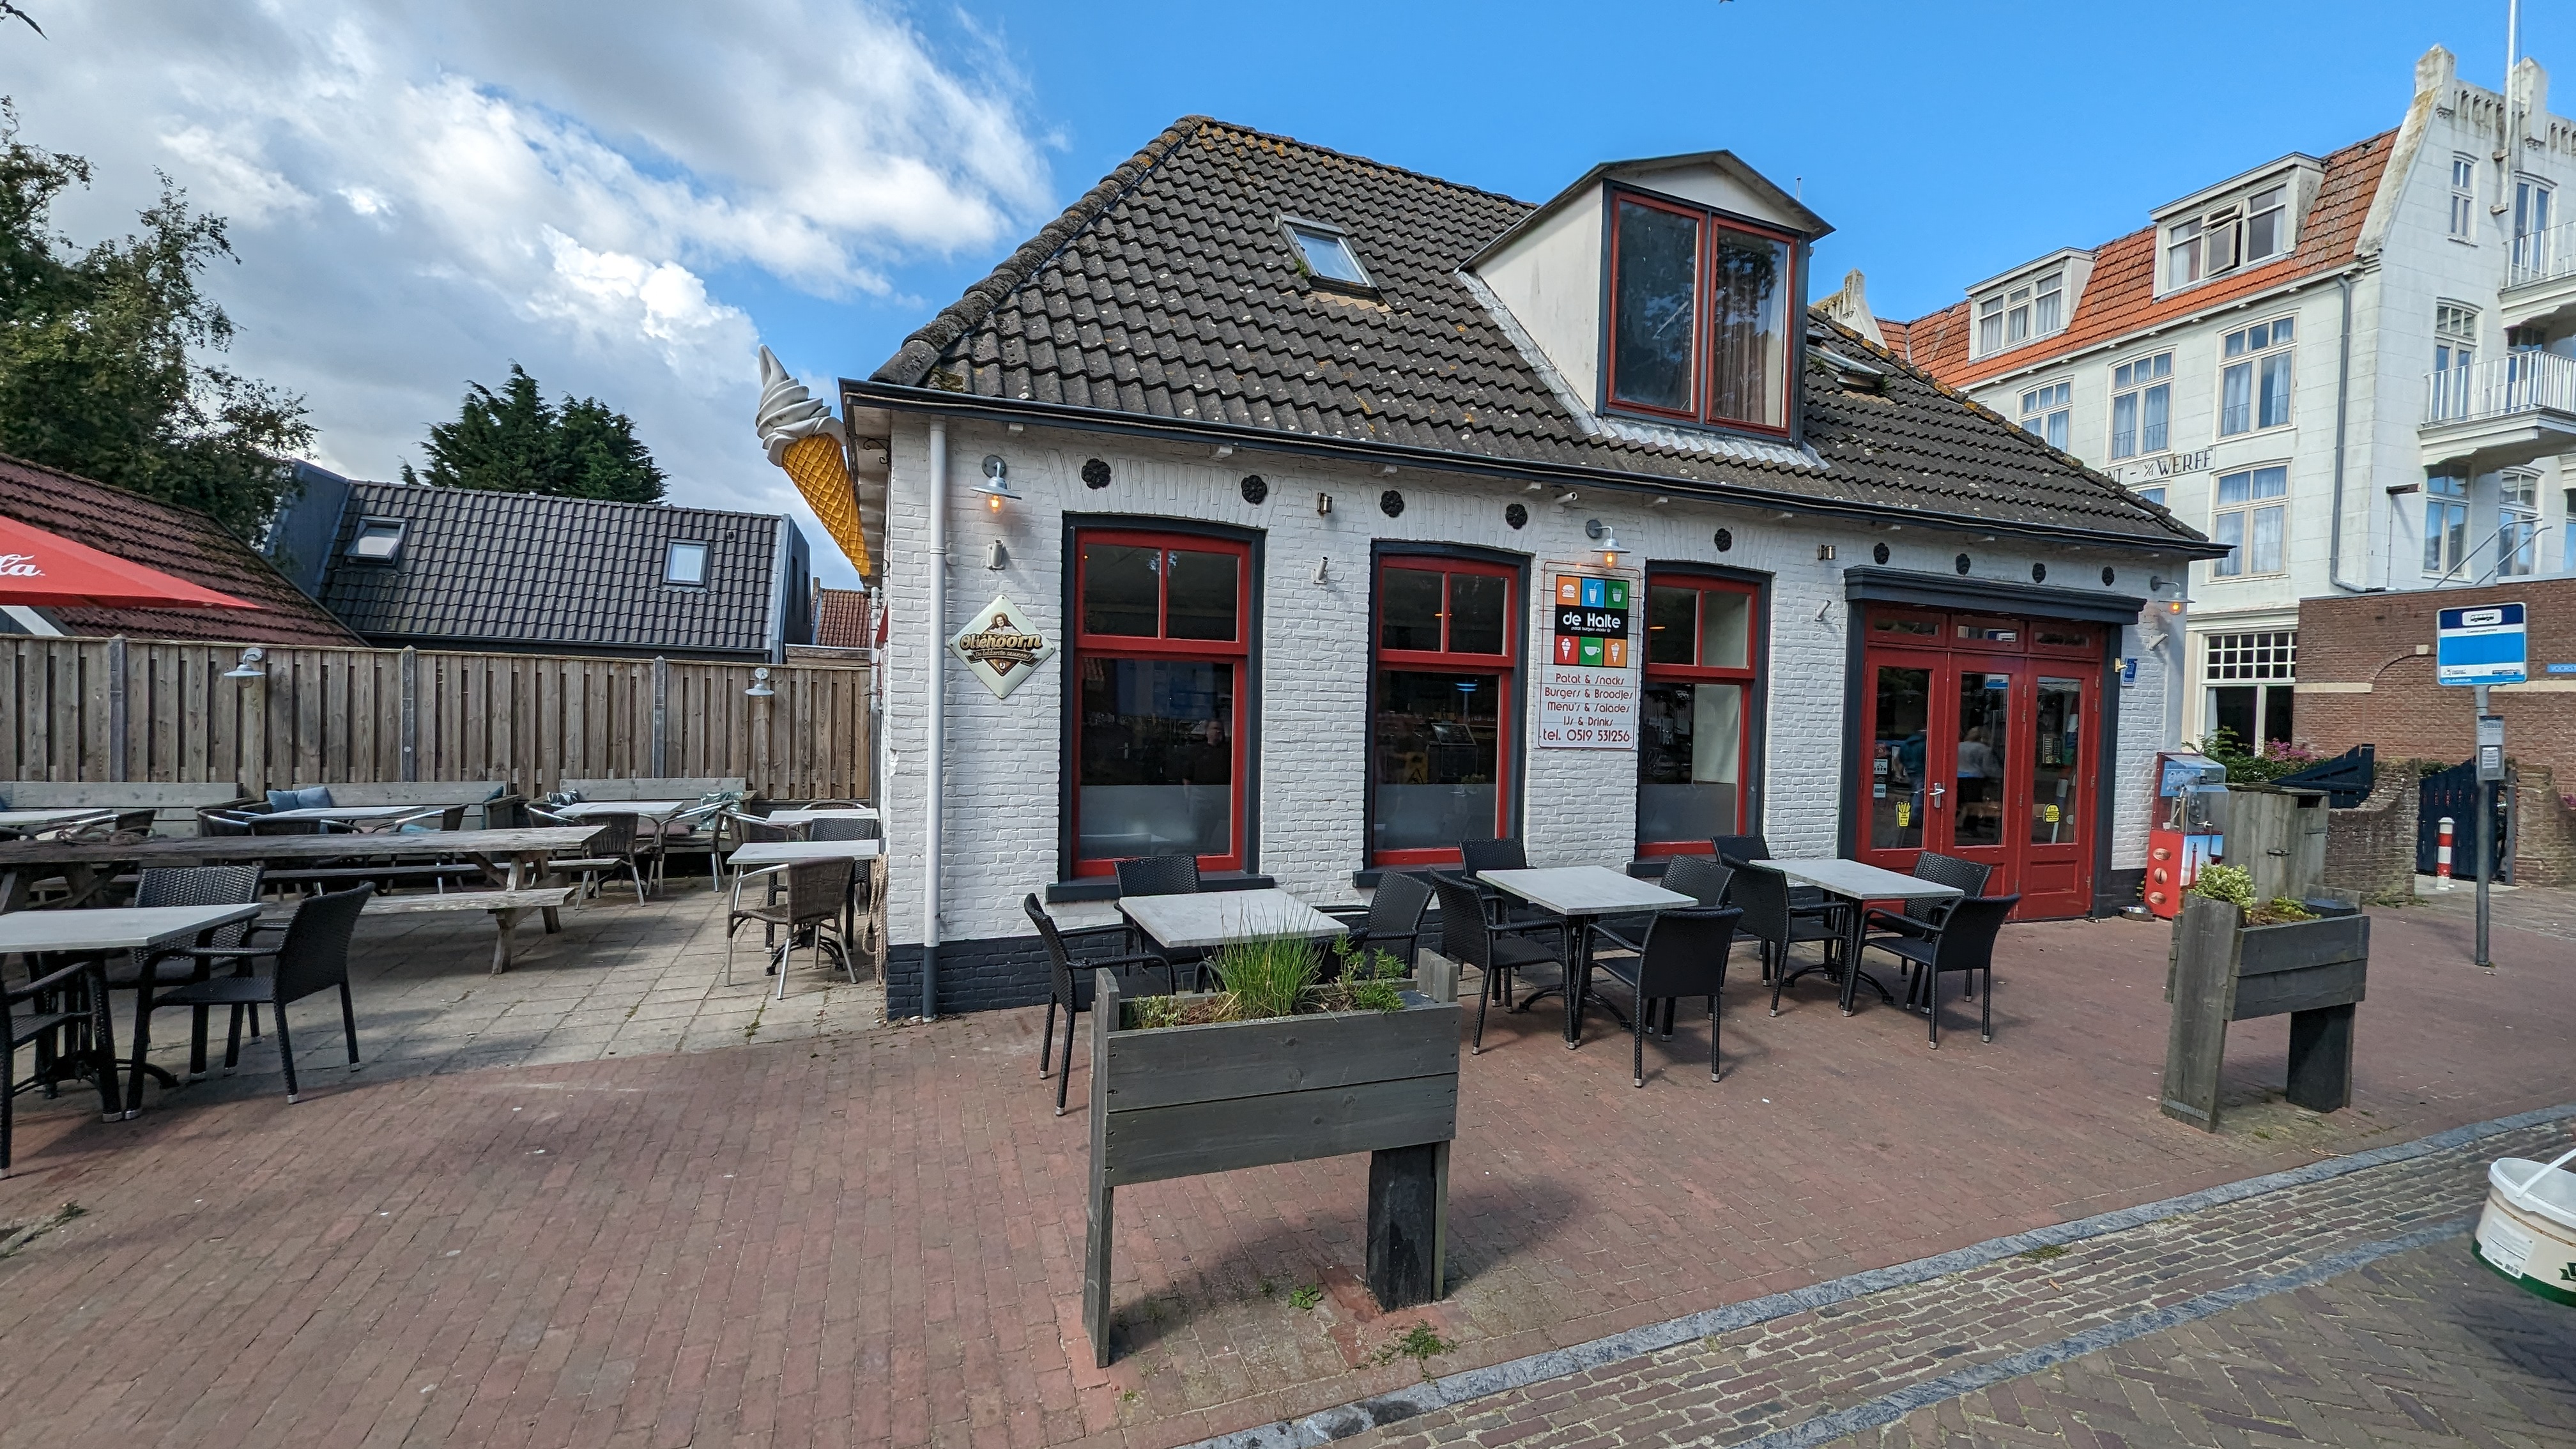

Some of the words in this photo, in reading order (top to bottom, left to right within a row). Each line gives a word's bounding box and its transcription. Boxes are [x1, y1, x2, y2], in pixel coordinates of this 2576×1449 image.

[2156, 448, 2213, 476] WERFF
[0, 553, 42, 576] la
[1563, 611, 1581, 626] de
[1587, 612, 1621, 629] Halte
[960, 634, 1042, 650] Oliehoorn
[1555, 673, 1581, 684] Patat
[1584, 675, 1591, 684] &
[1595, 674, 1625, 686] Snacks
[1544, 687, 1581, 700] Burgers
[1584, 689, 1590, 698] &
[1594, 689, 1633, 701] Broodjes
[1547, 701, 1581, 712] Menu's
[1584, 702, 1590, 712] &
[1593, 702, 1630, 714] Salades
[1577, 716, 1584, 726] &
[1588, 716, 1613, 727] Drinks
[1543, 728, 1561, 741] tel.
[1567, 729, 1593, 742] 0519
[1597, 730, 1630, 742] 531256
